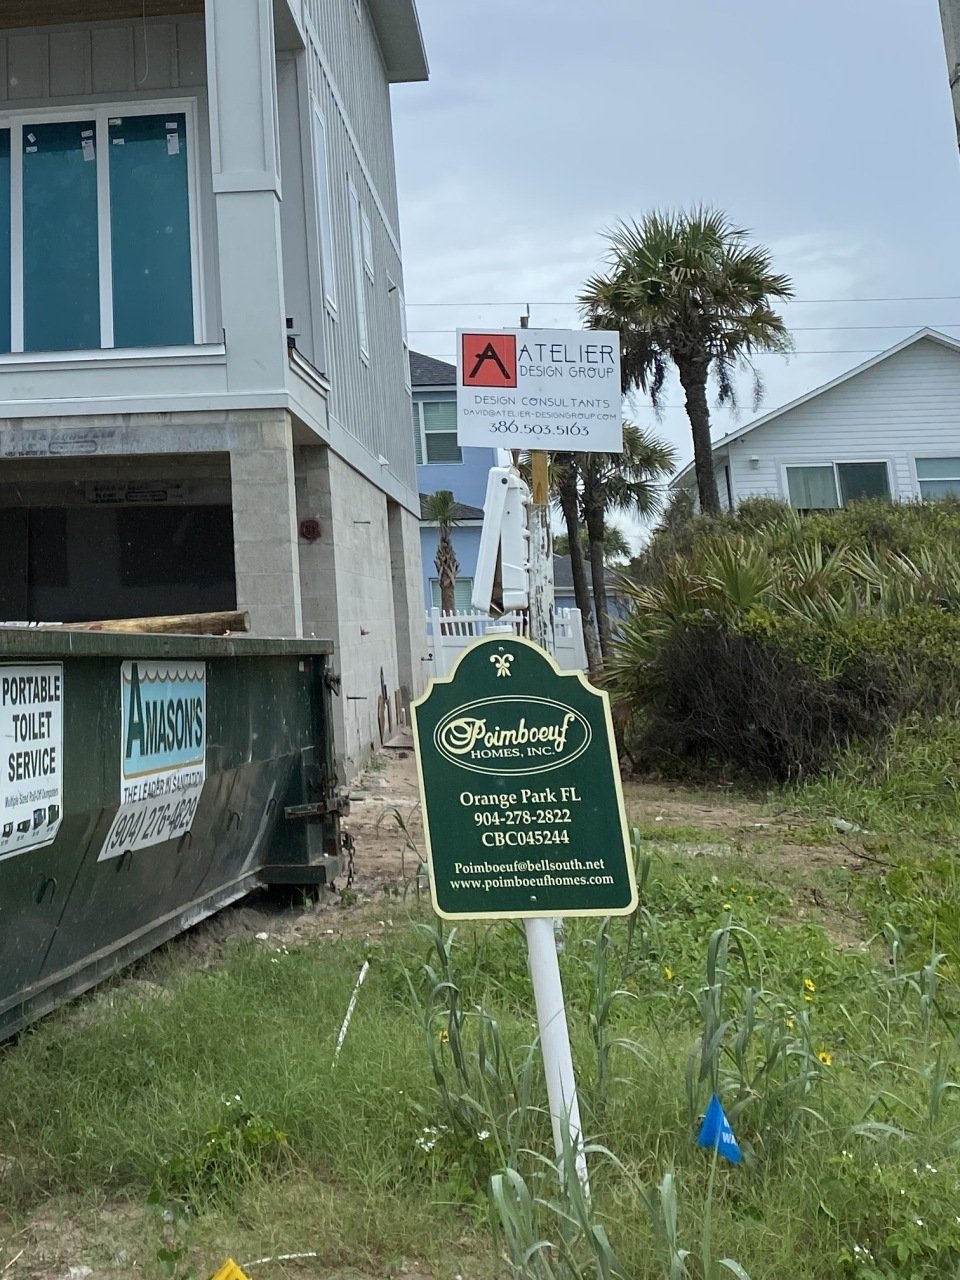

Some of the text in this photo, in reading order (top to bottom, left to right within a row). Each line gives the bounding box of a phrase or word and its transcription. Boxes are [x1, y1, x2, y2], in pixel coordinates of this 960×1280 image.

[518, 343, 615, 364] ATELIER
[519, 365, 614, 379] DESIGN GROUP
[474, 395, 610, 409] DESIGN CONSULTANTS
[489, 420, 590, 437] 386.503.5163
[2, 675, 61, 706] PORTABLE
[12, 711, 53, 744] TOILET
[441, 712, 576, 756] Poimboeuf
[470, 745, 556, 760] HOMES, INC.
[8, 746, 56, 783] SERVICE
[123, 784, 138, 805] THE
[459, 786, 582, 809] Orange Park FL
[474, 808, 572, 827] 904-278-2822
[104, 805, 148, 855] (904)
[481, 829, 571, 847] CBC045244
[454, 857, 605, 875] Poimboeuf@bellsouth.net
[449, 874, 615, 892] www.poimboeufhomes.com
